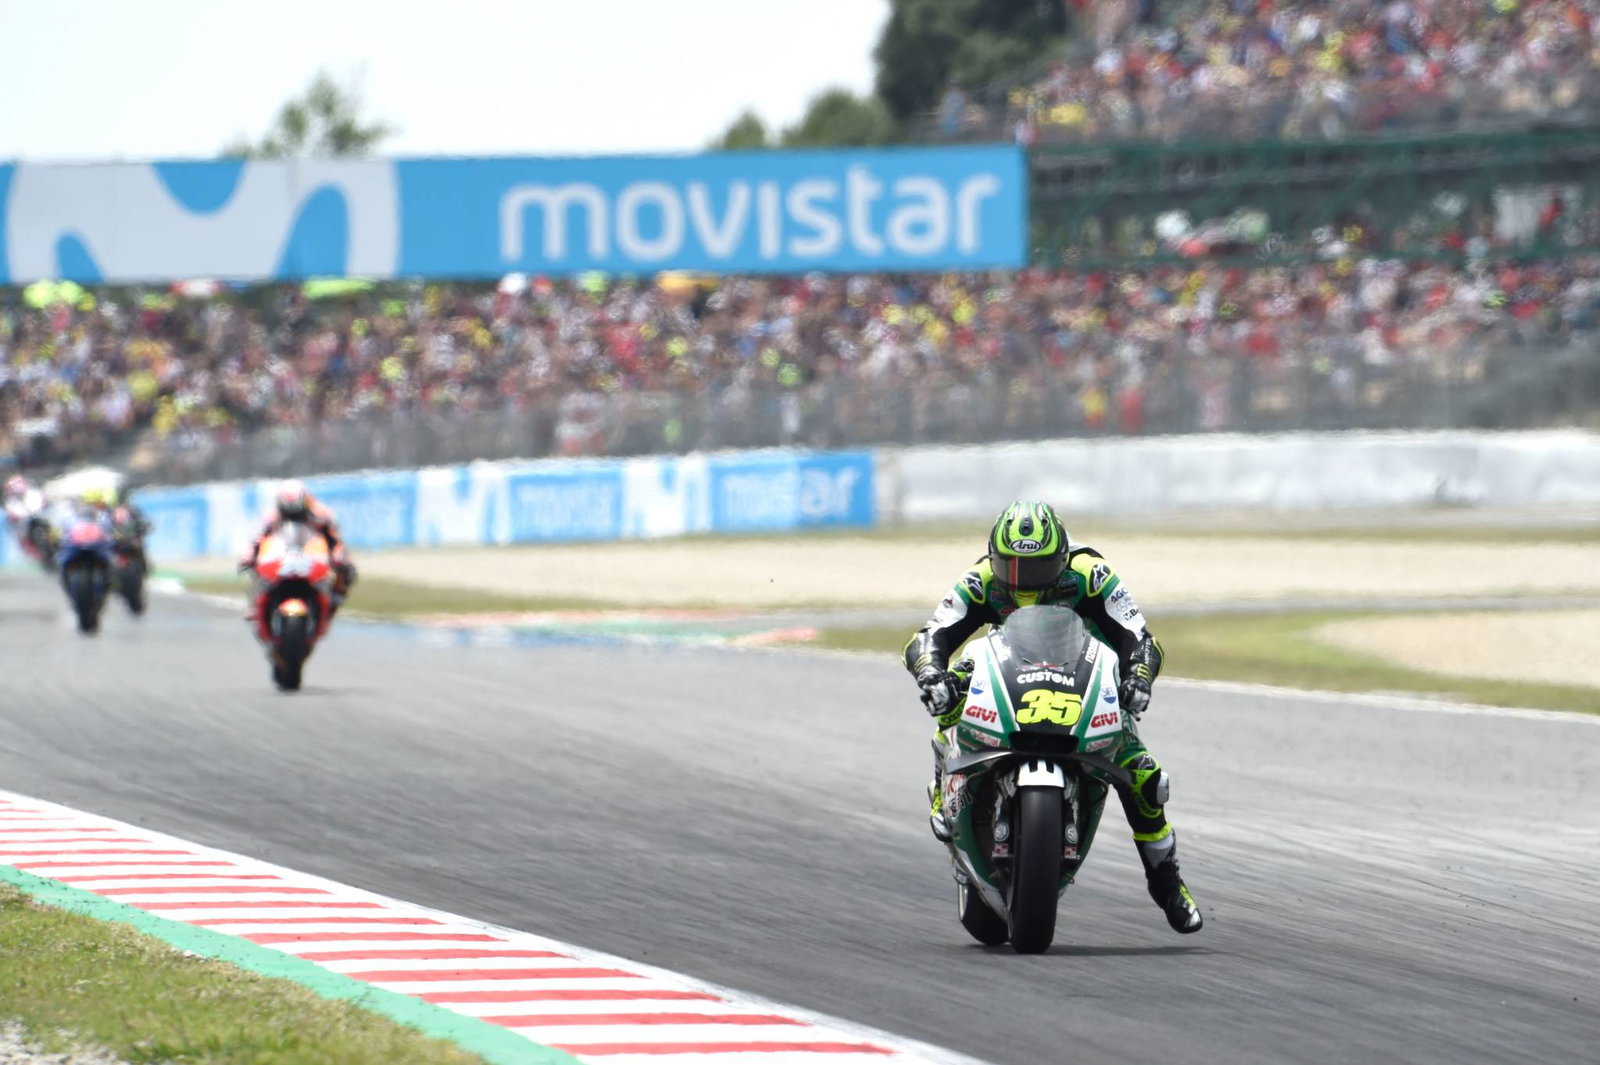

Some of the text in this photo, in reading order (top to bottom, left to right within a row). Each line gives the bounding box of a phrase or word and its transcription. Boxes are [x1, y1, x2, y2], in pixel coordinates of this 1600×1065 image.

[501, 165, 1001, 261] movistar
[1013, 540, 1038, 550] Arai
[1016, 671, 1075, 687] CUSTOM
[966, 705, 997, 723] GIVI
[1017, 689, 1082, 726] 35
[1090, 712, 1119, 728] GIVI
